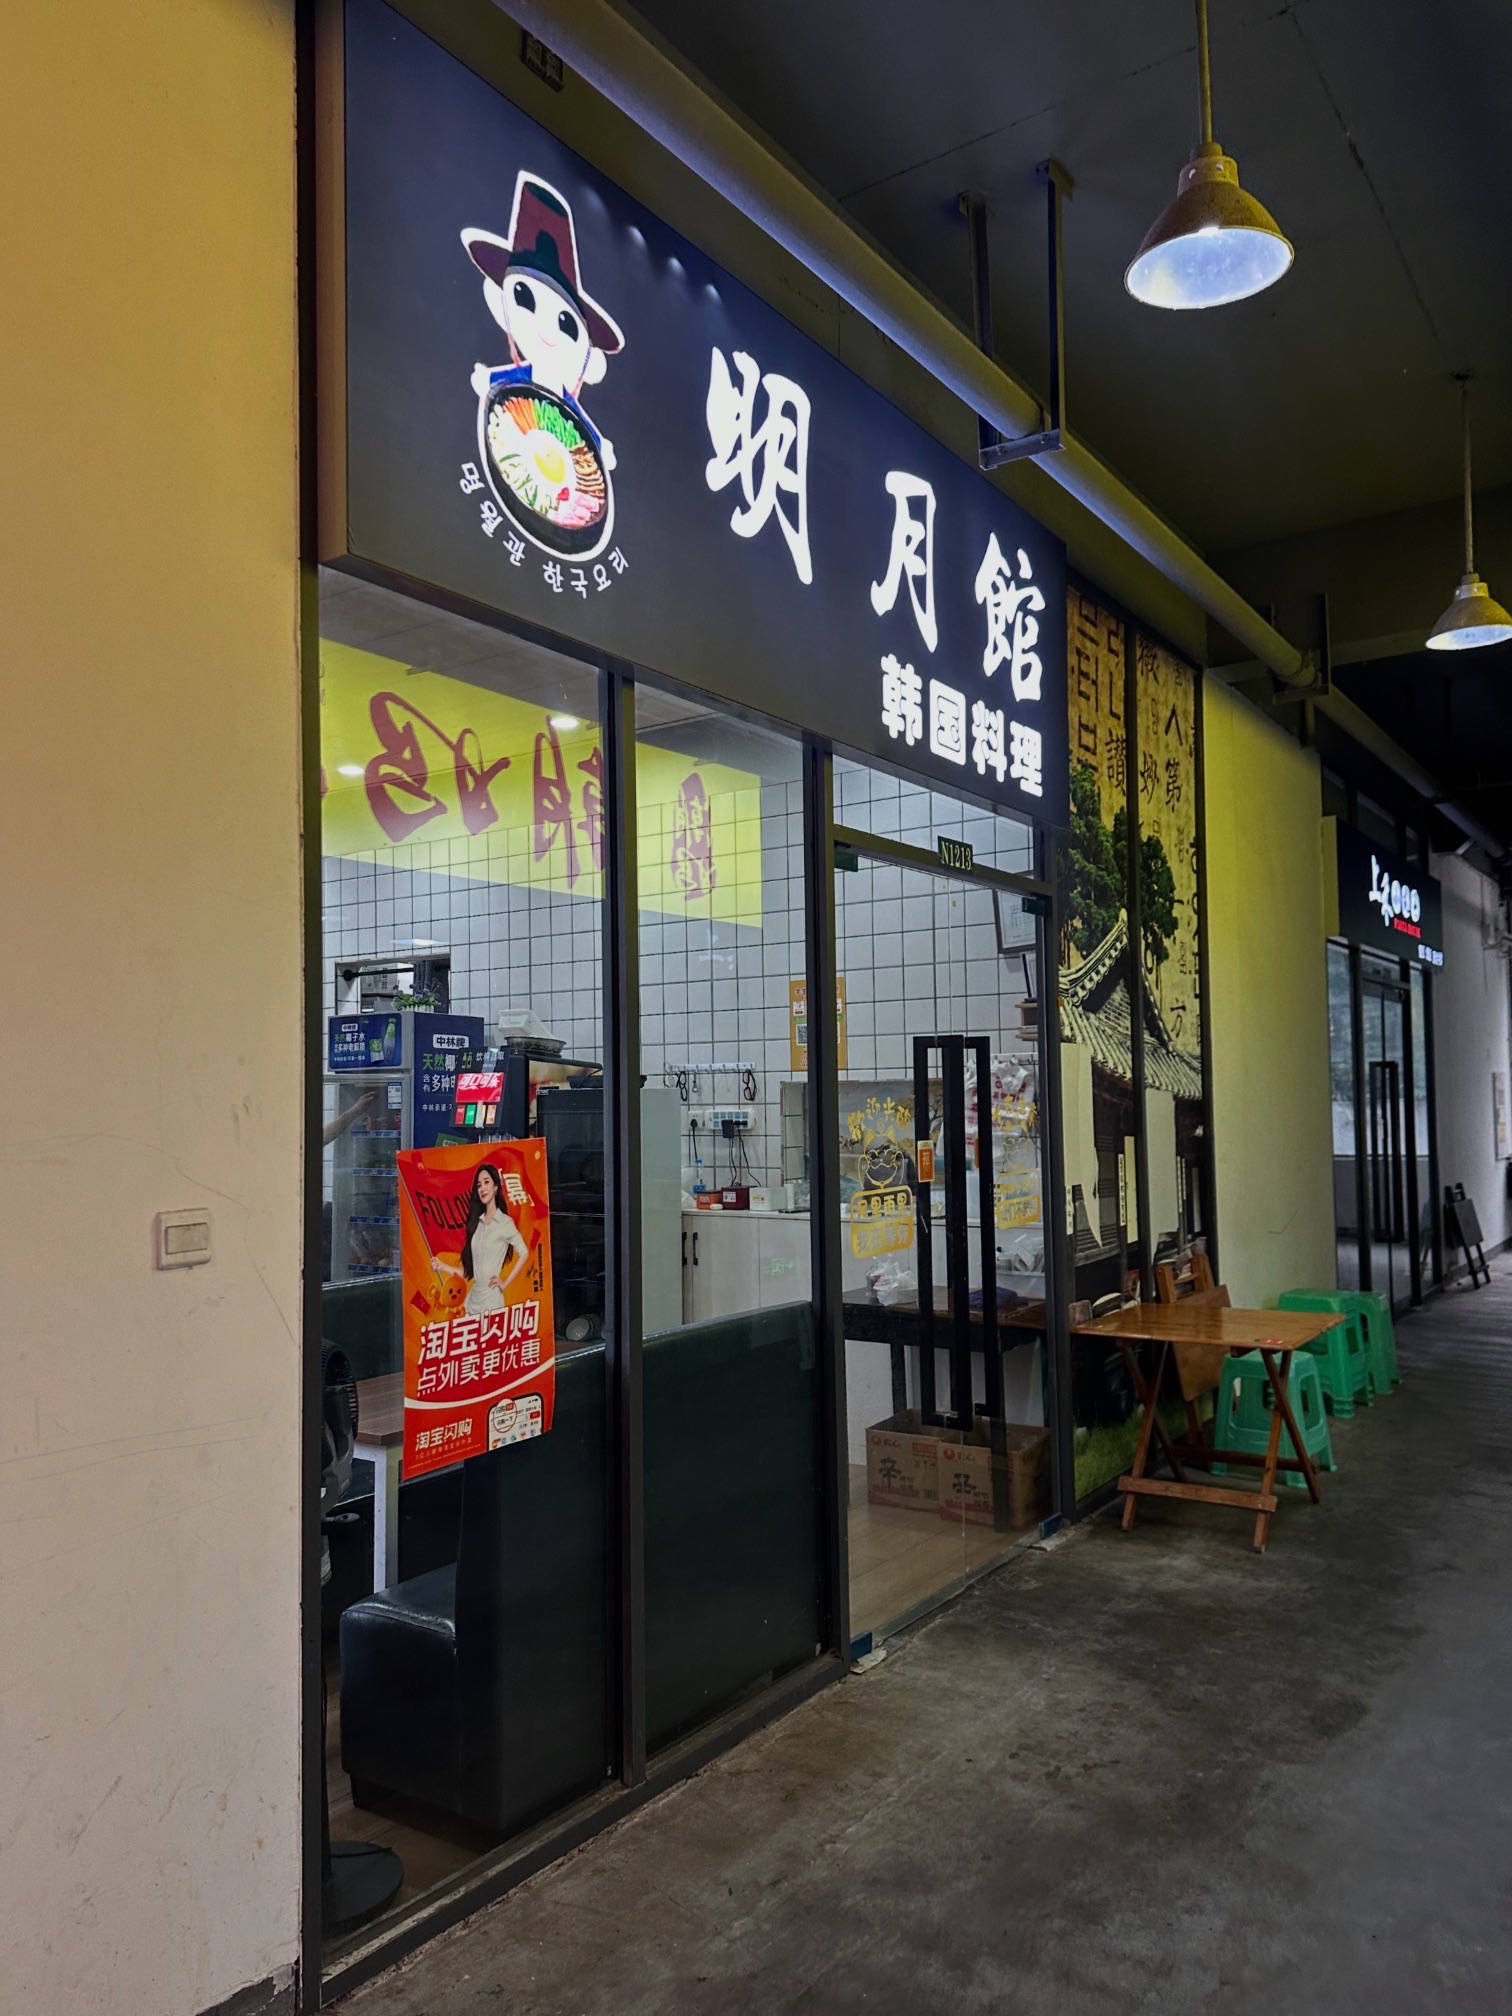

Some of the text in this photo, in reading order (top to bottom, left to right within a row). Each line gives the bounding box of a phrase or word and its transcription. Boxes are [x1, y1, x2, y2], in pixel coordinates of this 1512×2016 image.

[459, 461, 630, 600] 명월관 한국요리
[880, 653, 1044, 798] 韩国料理
[940, 840, 973, 871] N1213
[436, 1035, 466, 1047] 中林牌
[422, 1052, 457, 1072] 天然椰
[459, 1072, 501, 1091] 可口可乐
[418, 1298, 541, 1365] 淘宝闪购
[416, 1337, 542, 1398] 点外卖更优惠
[415, 1417, 473, 1452] 淘宝闪购
